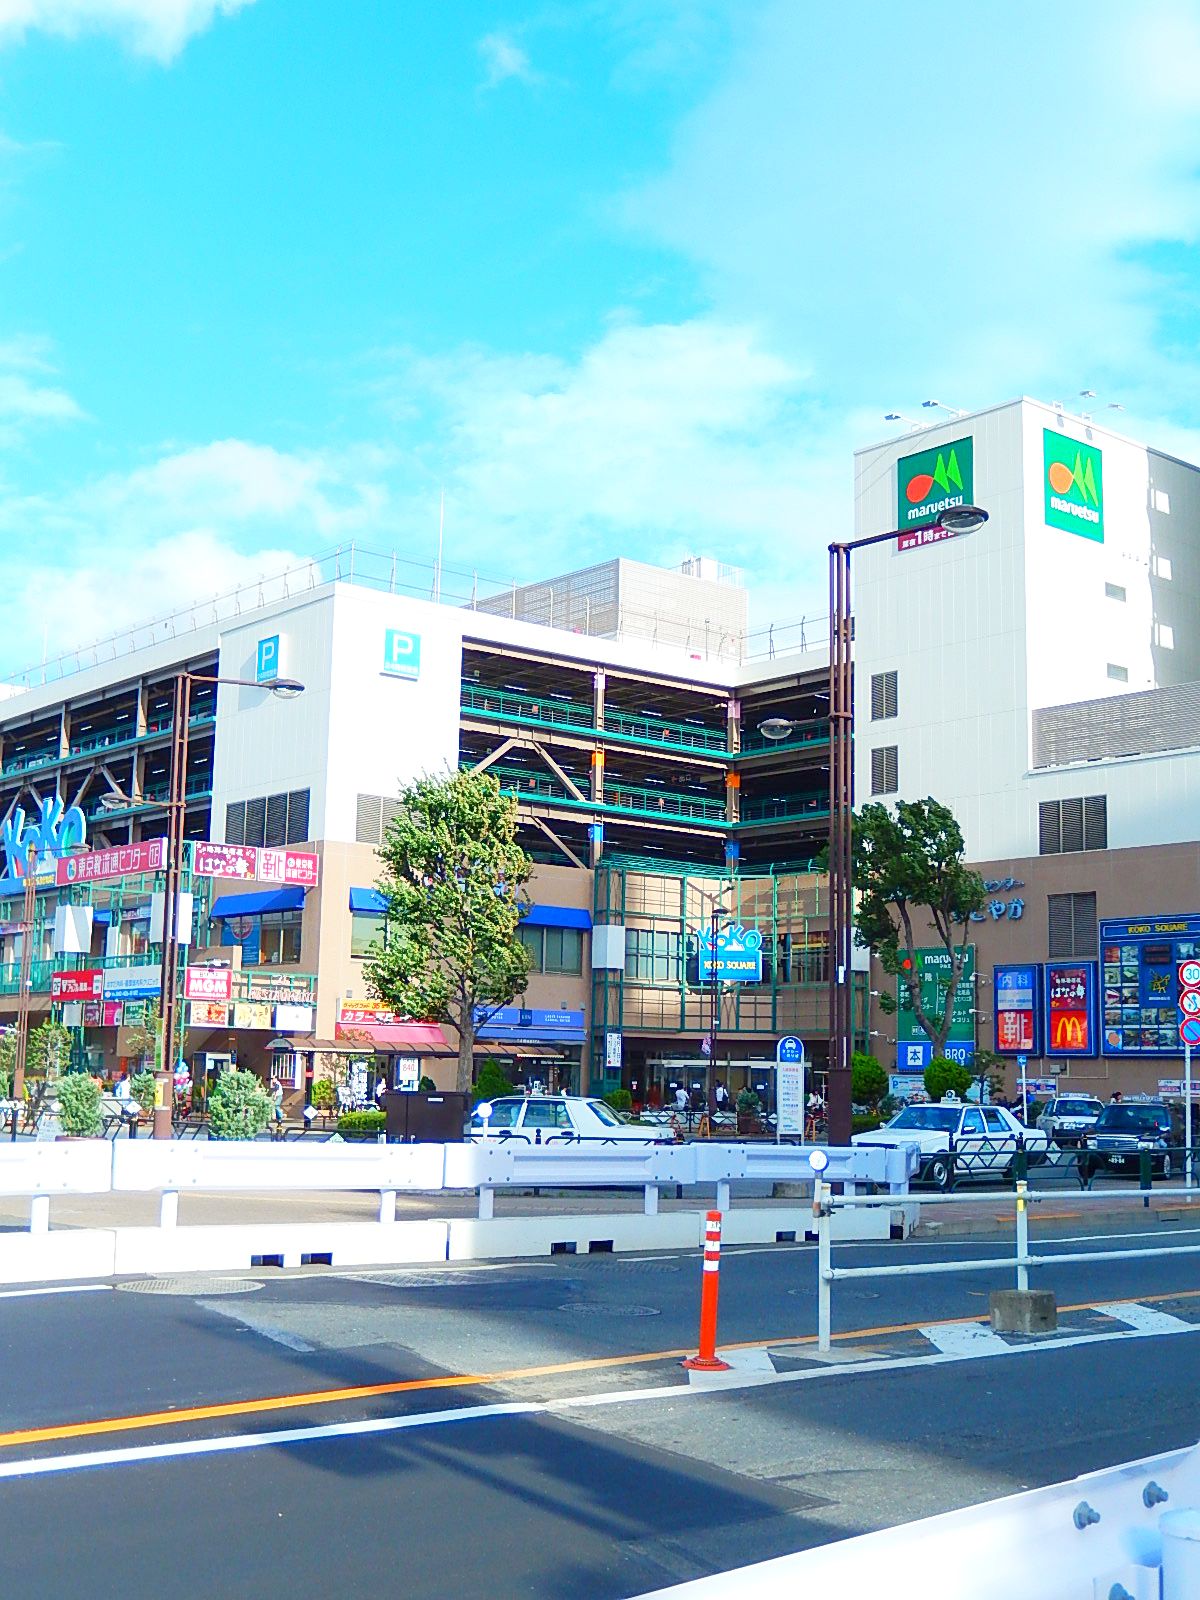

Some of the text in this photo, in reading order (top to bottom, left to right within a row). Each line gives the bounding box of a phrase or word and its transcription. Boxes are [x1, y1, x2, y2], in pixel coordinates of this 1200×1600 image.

[908, 495, 963, 520] maruetsu
[1050, 496, 1100, 524] maruetsu
[262, 641, 275, 671] P
[392, 634, 413, 661] P
[1154, 922, 1188, 932] SQUARE
[1002, 974, 1028, 987] 内科
[1185, 968, 1200, 980] 30
[189, 979, 227, 993] MGM
[1003, 1012, 1029, 1042] 靴
[909, 1049, 921, 1062] 本
